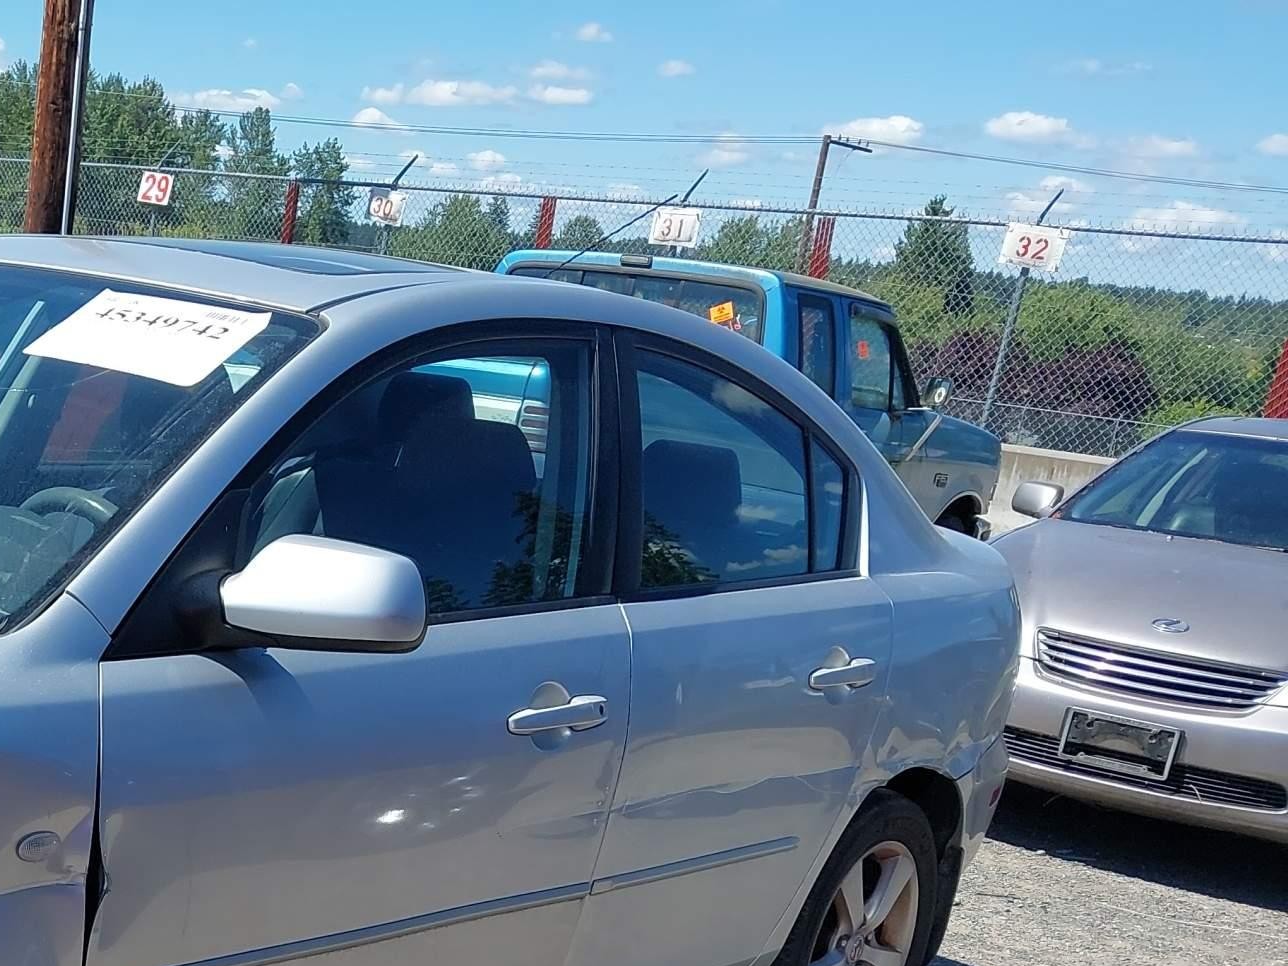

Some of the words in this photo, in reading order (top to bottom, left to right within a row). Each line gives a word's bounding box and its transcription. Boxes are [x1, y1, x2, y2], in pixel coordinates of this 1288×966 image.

[140, 173, 171, 202] 29
[372, 197, 393, 216] 30
[661, 217, 684, 239] 31
[1015, 235, 1049, 260] 32
[95, 307, 230, 340] 45349742
